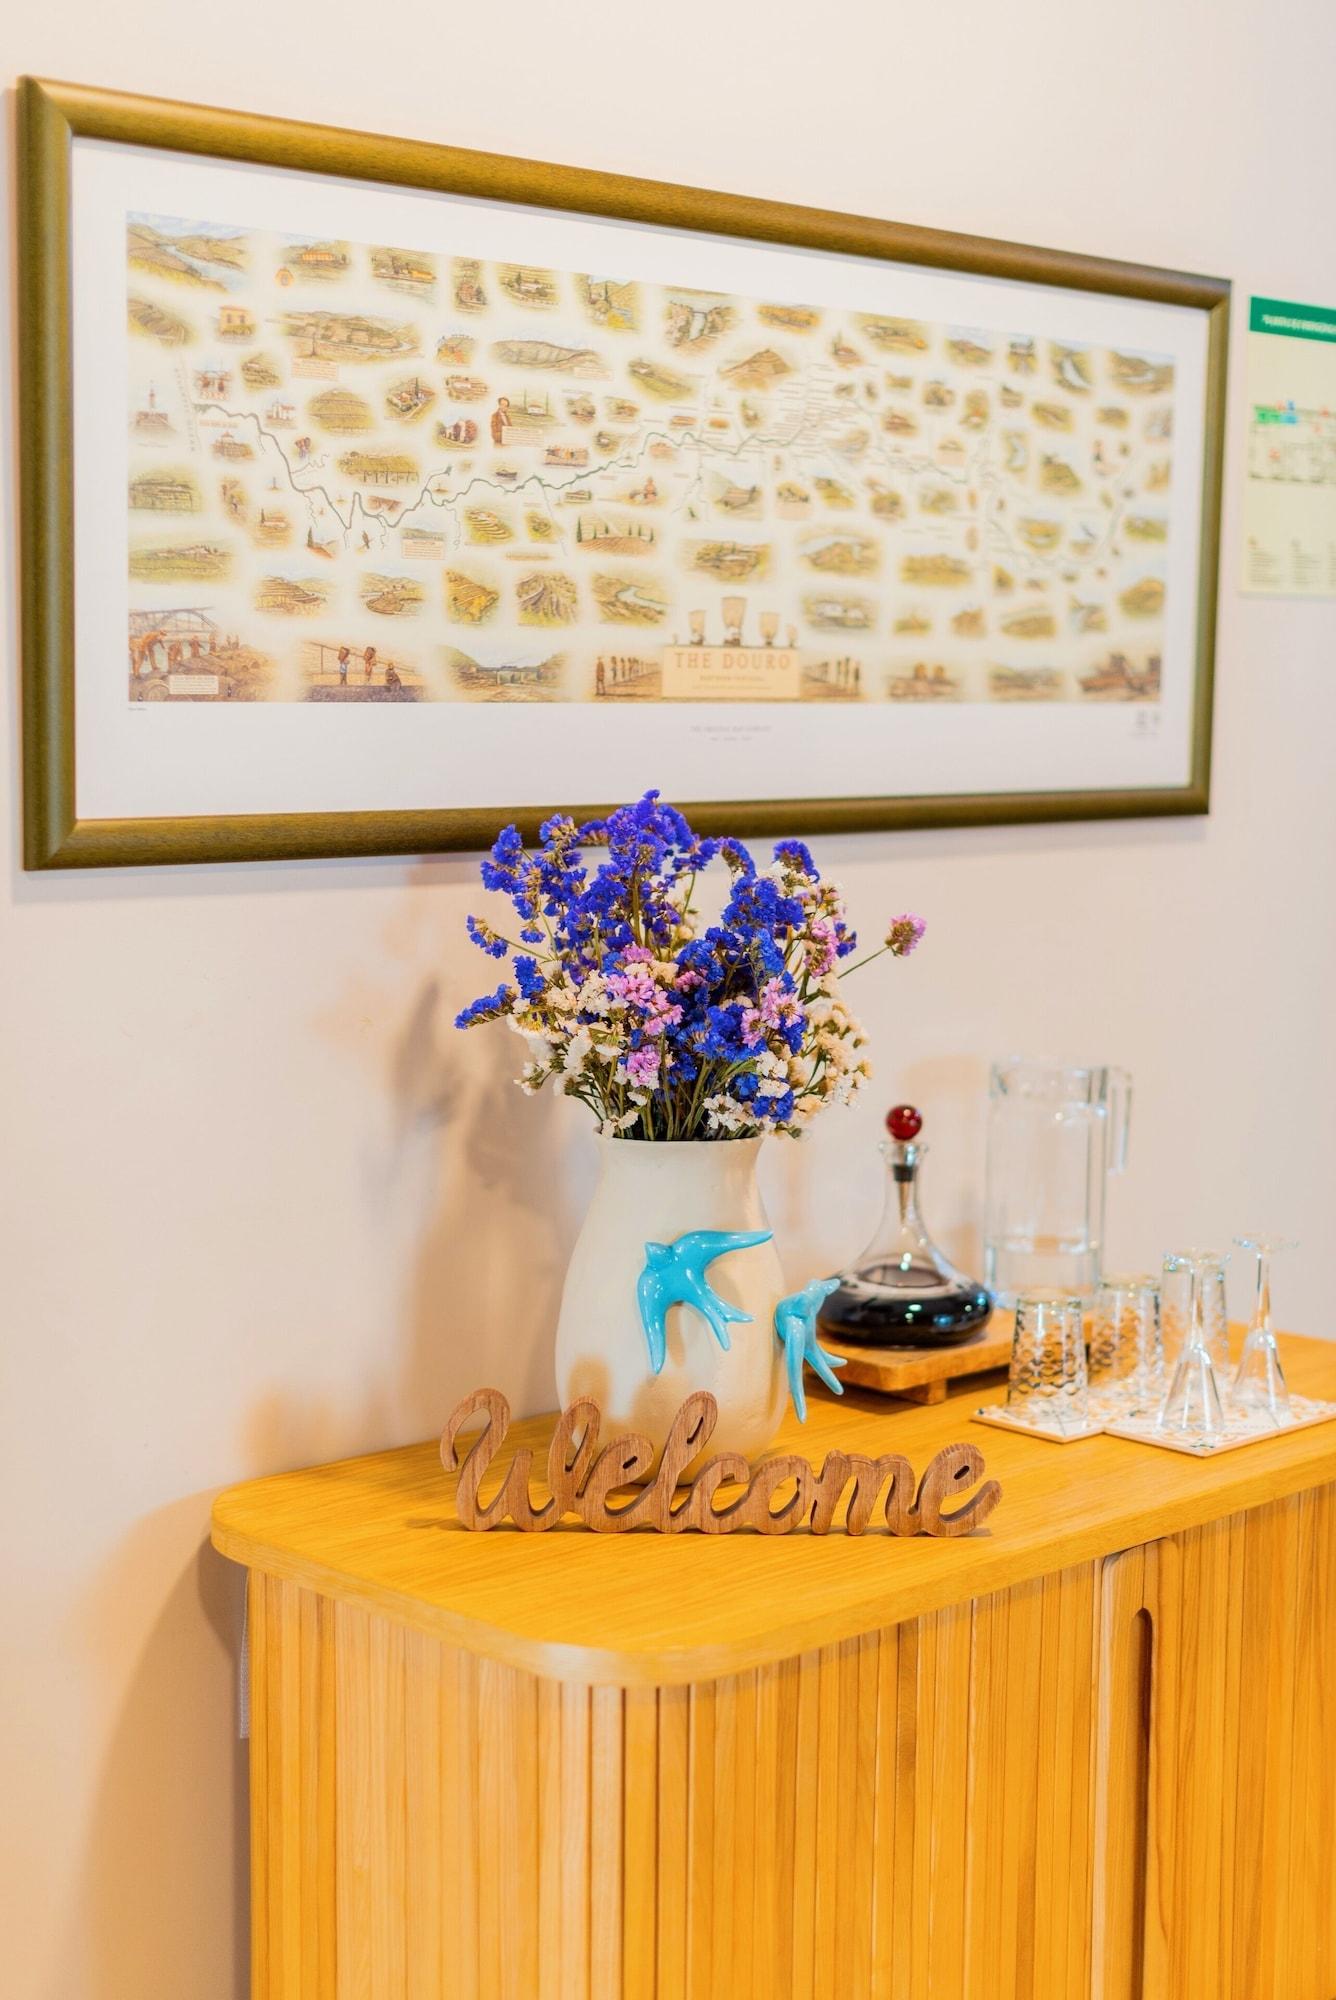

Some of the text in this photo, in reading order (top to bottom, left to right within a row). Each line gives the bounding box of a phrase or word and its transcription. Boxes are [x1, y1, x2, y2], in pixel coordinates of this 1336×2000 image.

[674, 652, 791, 670] THE DOURO
[439, 1387, 1003, 1537] Welcome
